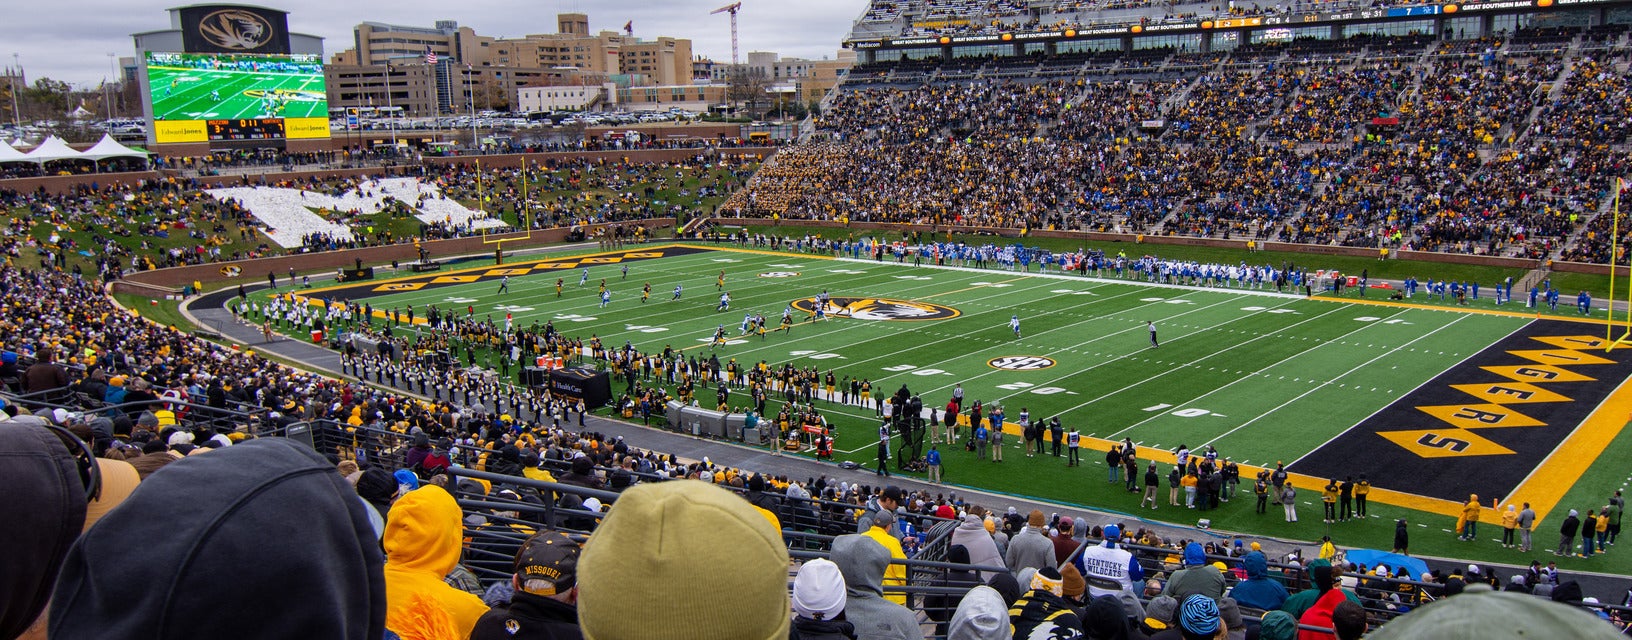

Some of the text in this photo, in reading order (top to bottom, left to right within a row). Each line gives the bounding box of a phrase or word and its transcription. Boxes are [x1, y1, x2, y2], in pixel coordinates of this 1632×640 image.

[992, 356, 1052, 369] SEC
[557, 381, 570, 390] Health
[995, 382, 1066, 395] 20
[1417, 338, 1602, 452] TIGERS
[1142, 403, 1210, 417] 10
[1087, 558, 1122, 570] KENTUCKY
[525, 565, 561, 580] MISSOURI
[1087, 565, 1122, 577] WILDCATS
